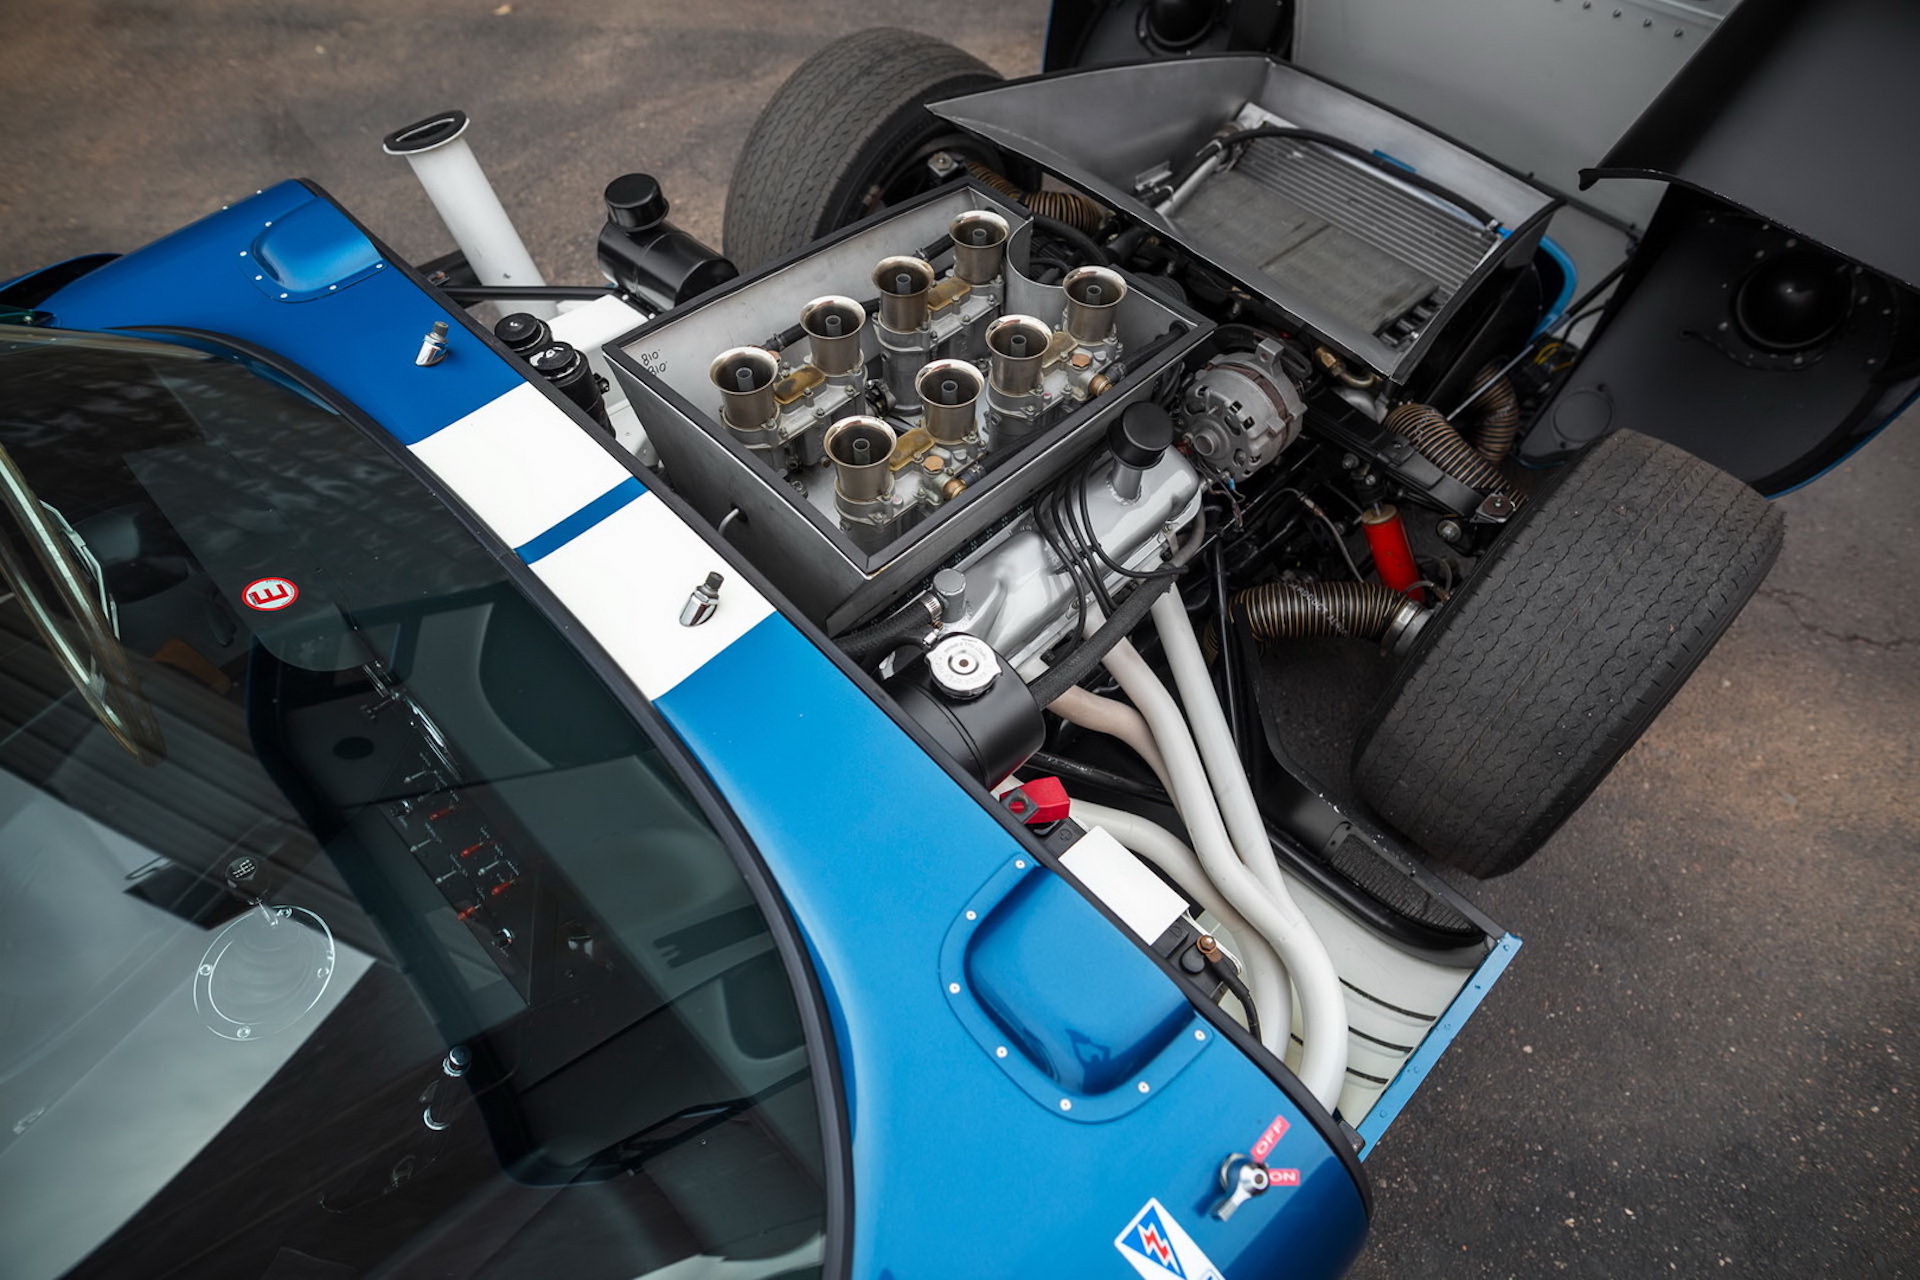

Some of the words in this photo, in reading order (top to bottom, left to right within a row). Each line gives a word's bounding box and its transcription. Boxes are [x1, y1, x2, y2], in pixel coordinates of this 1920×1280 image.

[250, 584, 289, 605] E
[1255, 1121, 1285, 1155] OFF
[1269, 1171, 1297, 1183] ON
